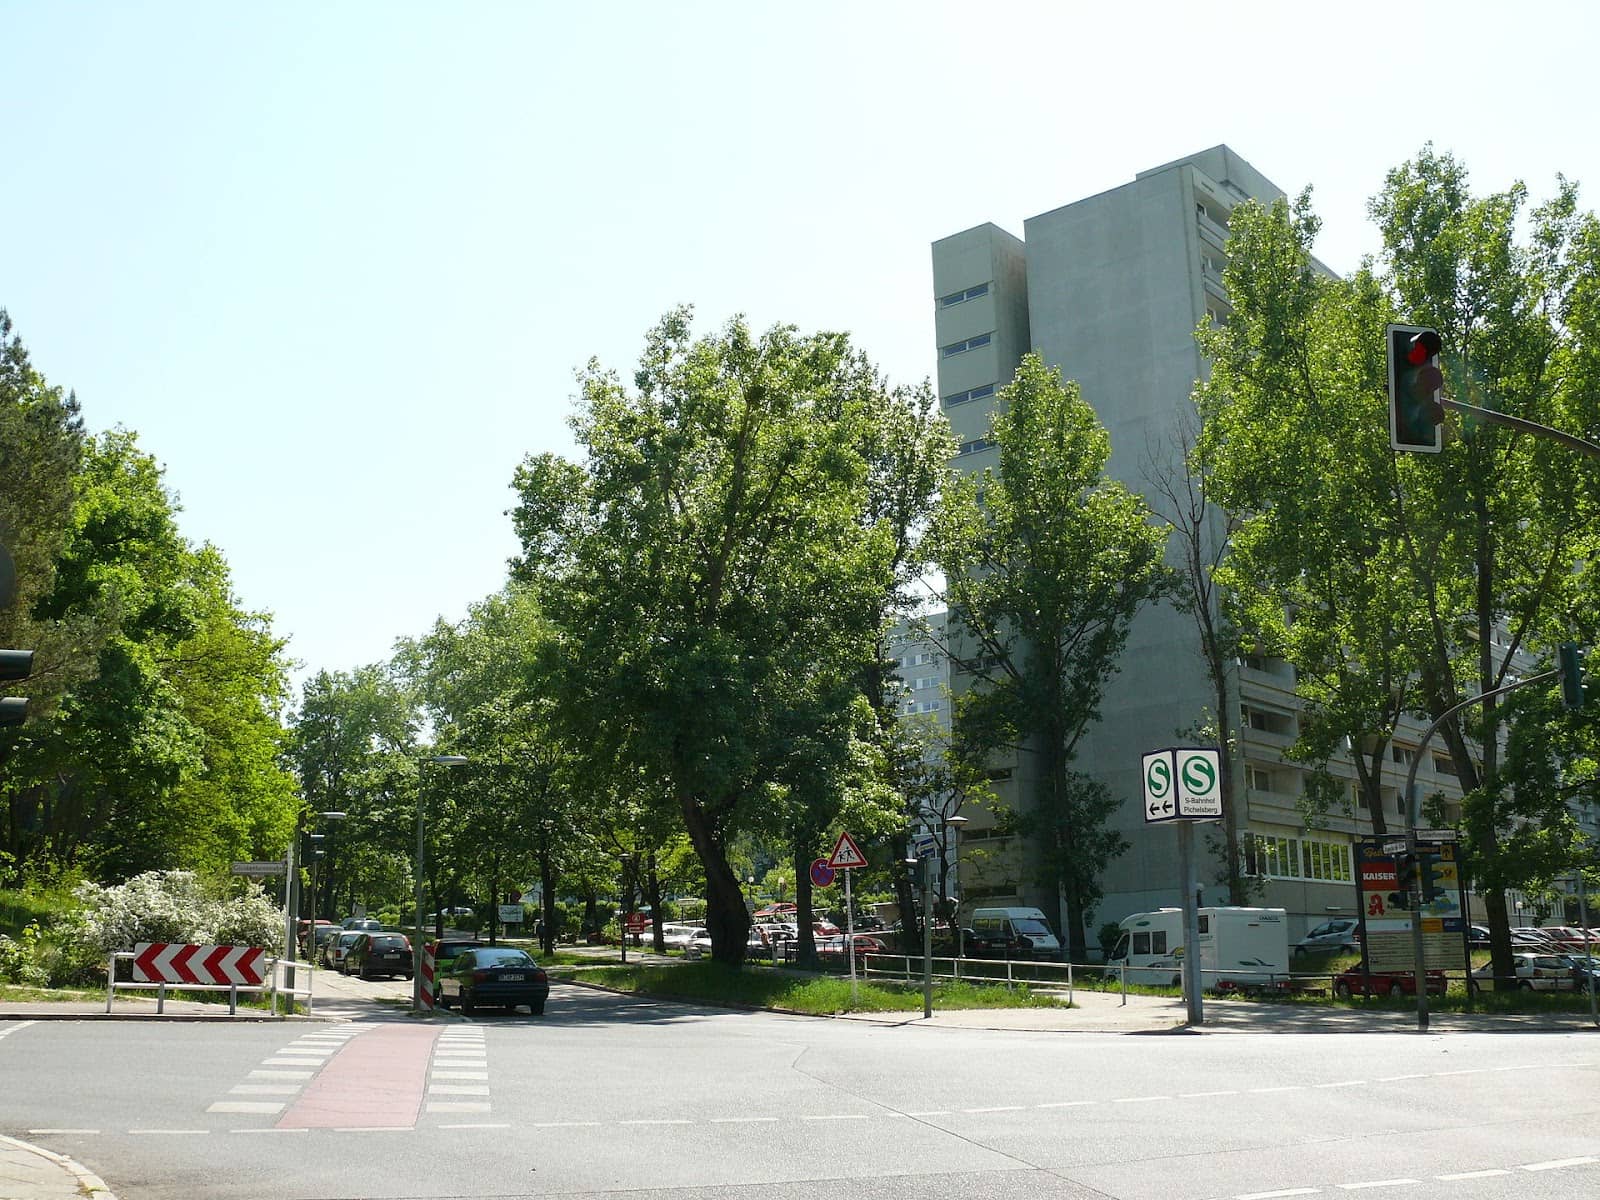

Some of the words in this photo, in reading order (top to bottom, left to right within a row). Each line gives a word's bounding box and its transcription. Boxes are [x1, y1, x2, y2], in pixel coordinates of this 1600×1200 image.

[1150, 760, 1168, 796] S
[1186, 759, 1211, 793] S
[1183, 806, 1218, 814] Pichelsberg
